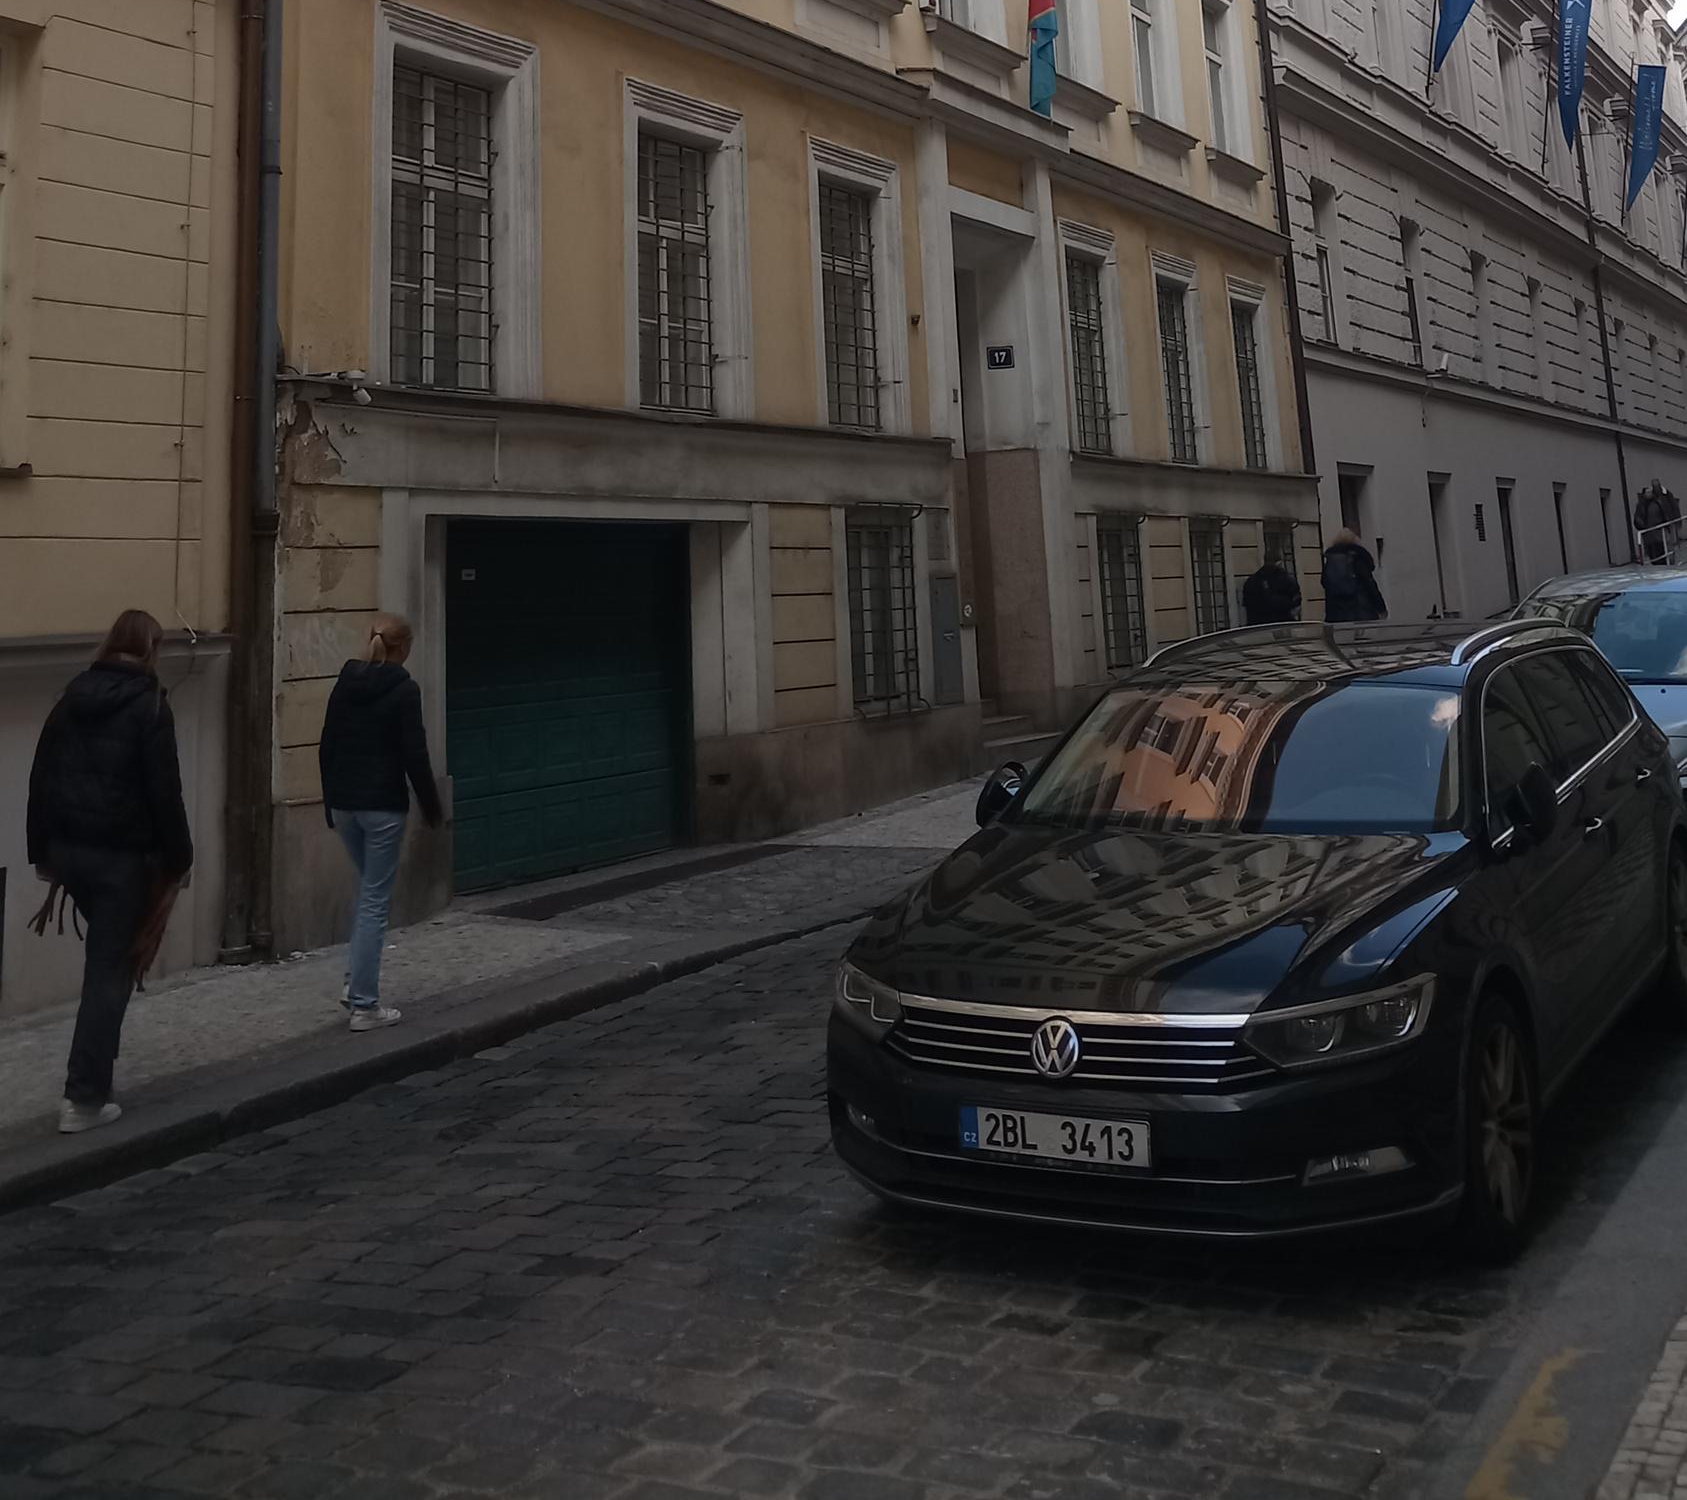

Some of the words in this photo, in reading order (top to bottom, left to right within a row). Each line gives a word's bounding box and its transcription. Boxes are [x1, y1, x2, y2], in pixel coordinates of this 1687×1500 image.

[1563, 18, 1574, 96] FALKENSTEINER
[994, 351, 1006, 364] 17
[963, 1132, 977, 1143] CZ
[985, 1112, 1038, 1151] 2BL
[1060, 1121, 1134, 1162] 3413
